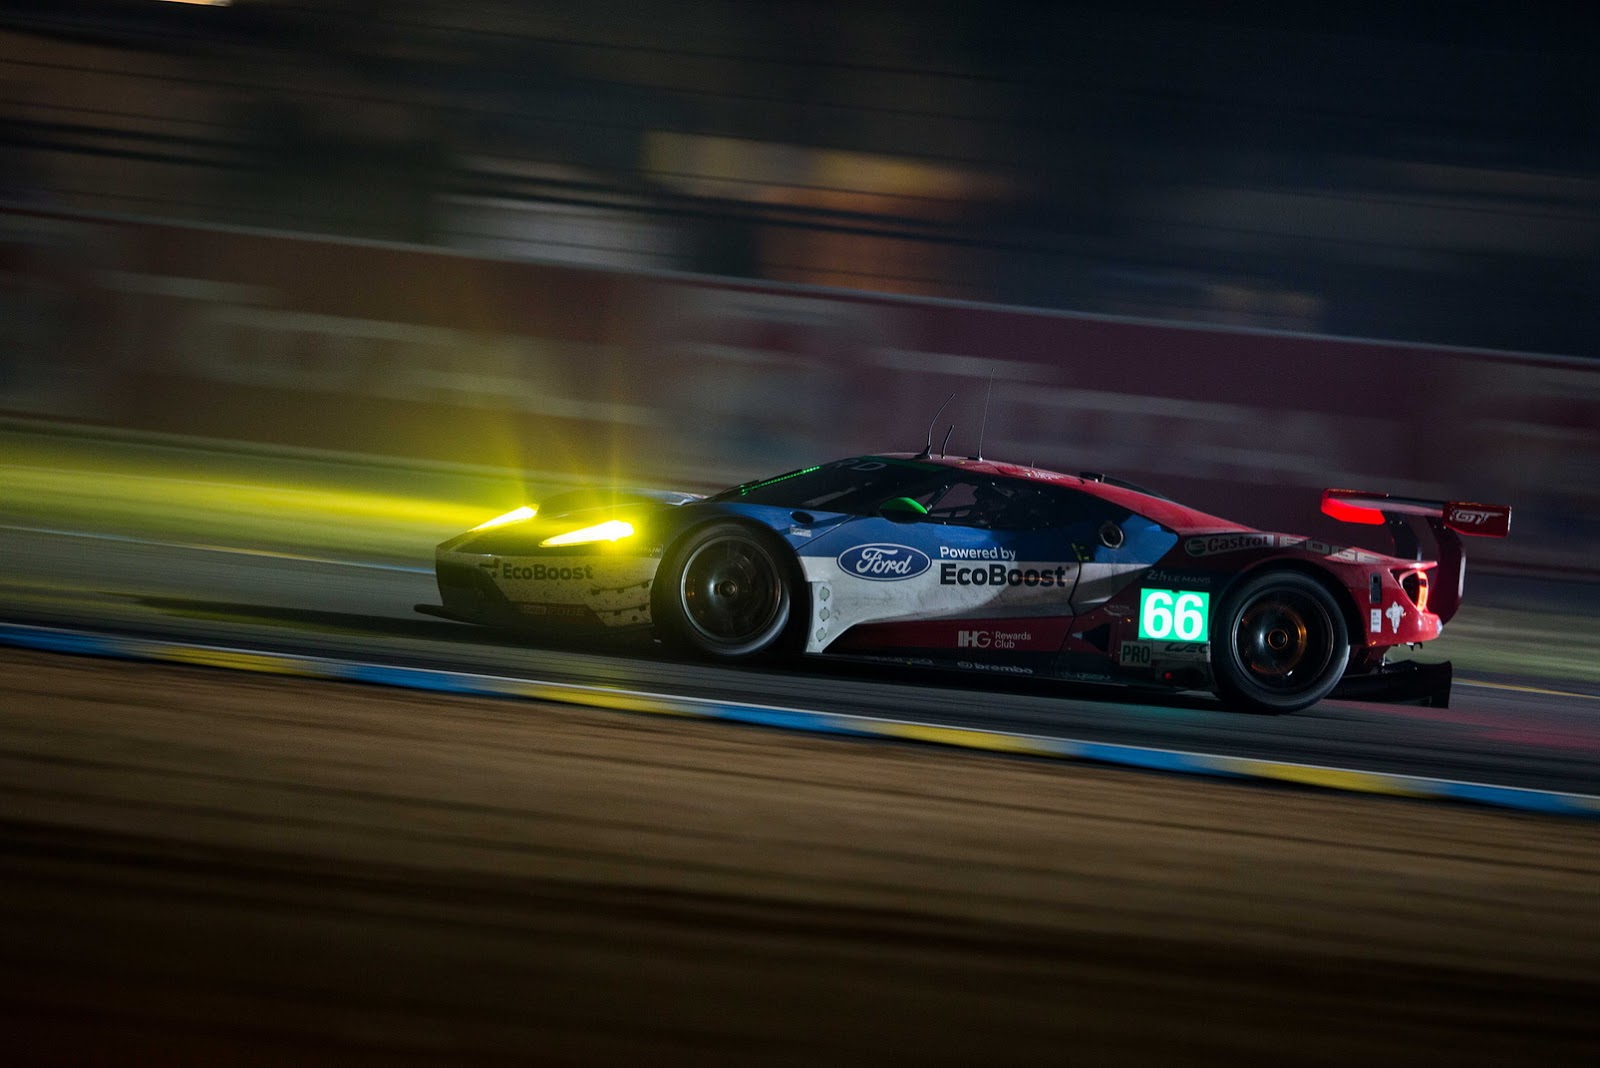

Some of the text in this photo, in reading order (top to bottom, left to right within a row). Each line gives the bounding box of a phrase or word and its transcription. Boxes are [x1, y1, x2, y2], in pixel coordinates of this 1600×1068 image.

[940, 546, 1017, 561] Powered by
[1207, 535, 1269, 554] Castrol
[855, 547, 913, 575] Ford
[502, 562, 594, 580] EcoBoost
[939, 563, 1066, 587] EcoBoost
[1143, 591, 1205, 641] 66
[957, 630, 991, 648] IHG
[994, 632, 1032, 641] Rewards
[994, 640, 1016, 649] Club
[1122, 645, 1151, 664] PRO
[974, 662, 1034, 674] brembo
